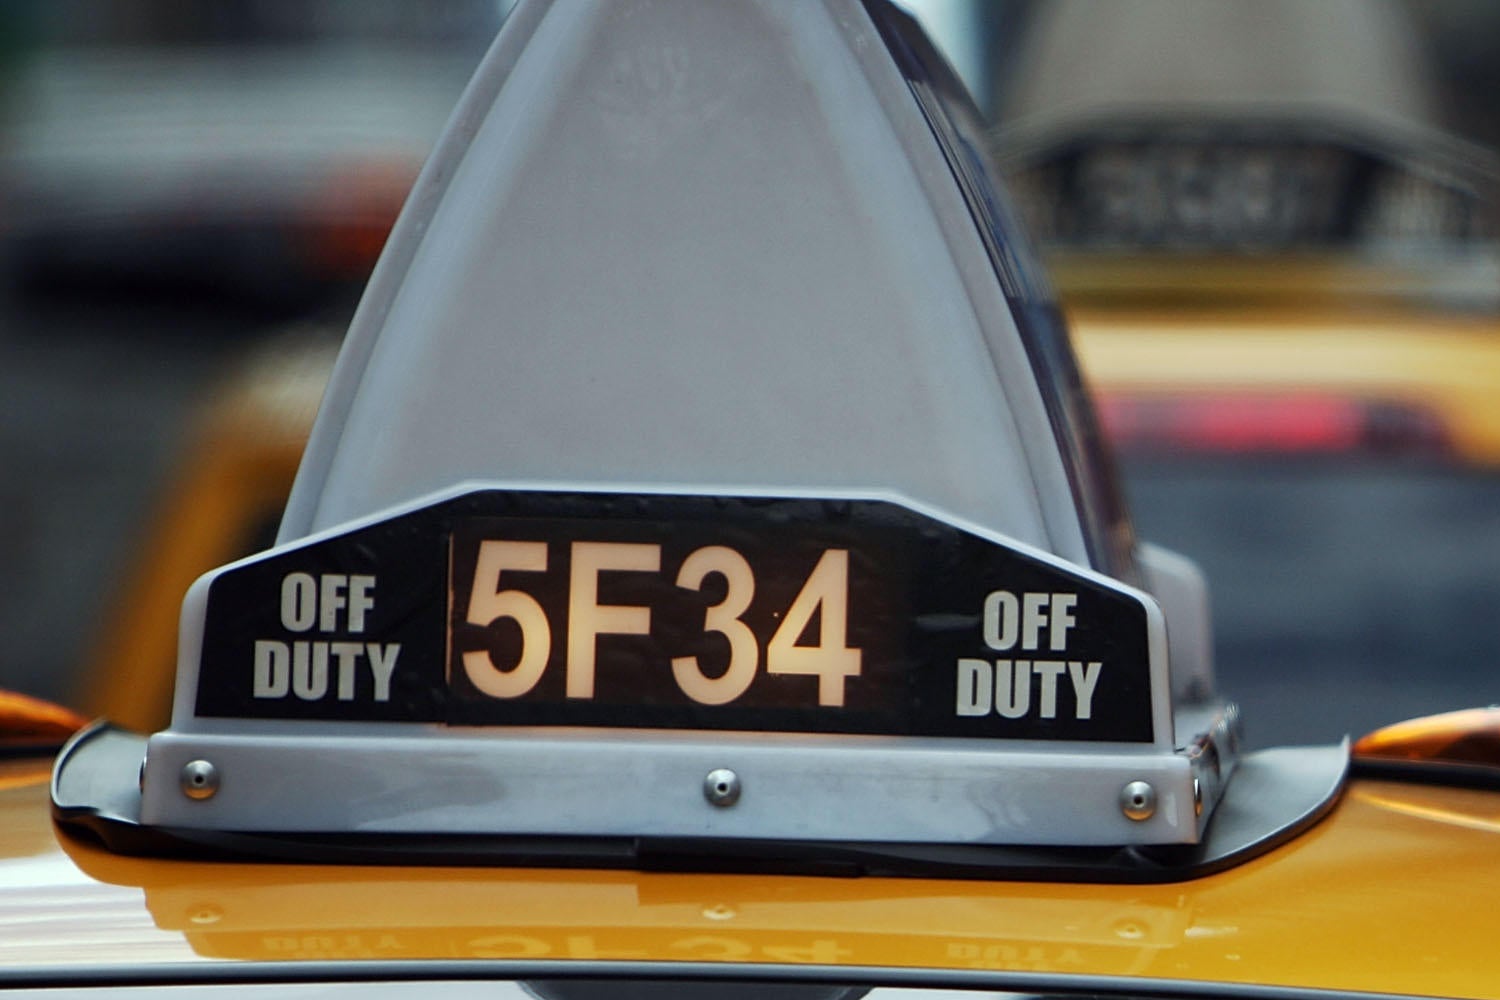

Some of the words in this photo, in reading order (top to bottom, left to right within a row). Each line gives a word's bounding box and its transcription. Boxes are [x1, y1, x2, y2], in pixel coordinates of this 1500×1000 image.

[279, 573, 377, 634] OFF
[462, 539, 863, 708] 5F34
[982, 591, 1078, 652] OFF
[252, 640, 402, 702] DUTY
[955, 658, 1103, 720] DUTY
